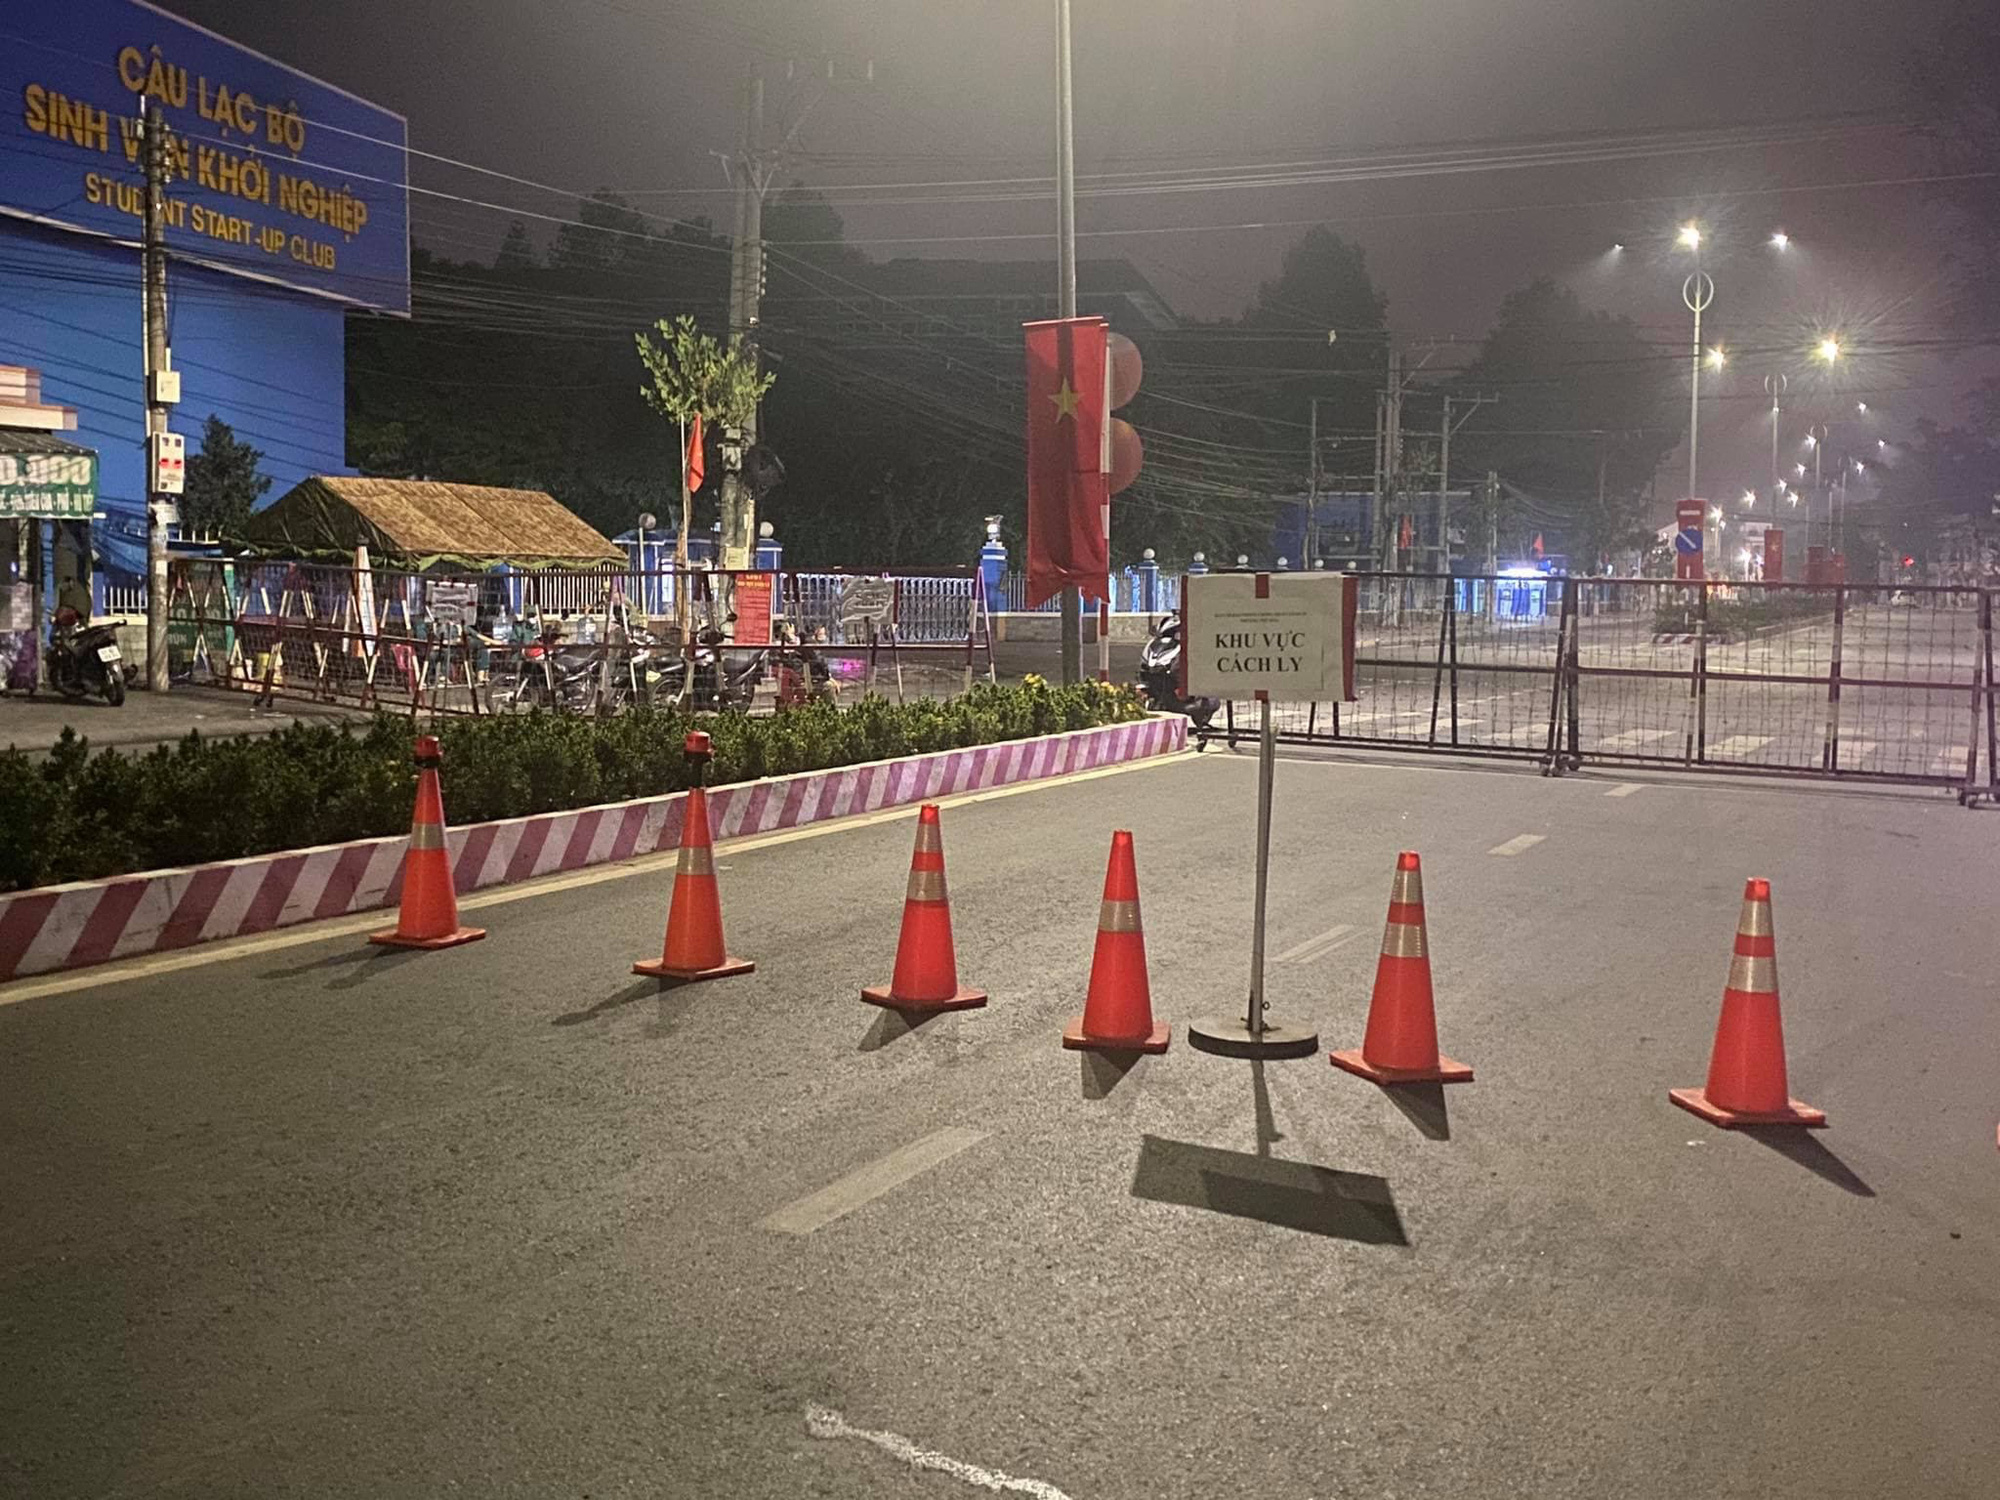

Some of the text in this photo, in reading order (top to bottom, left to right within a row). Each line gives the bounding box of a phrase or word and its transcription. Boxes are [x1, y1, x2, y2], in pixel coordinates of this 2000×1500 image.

[119, 44, 306, 160] CÂU LẠC BỘ
[26, 84, 368, 244] SINH VN KHỞI NGHIỆP
[86, 172, 188, 228] STUDNT
[291, 234, 336, 270] CLUB
[1216, 630, 1306, 652] KHU VỰC
[1217, 652, 1303, 673] CÁCH LY
